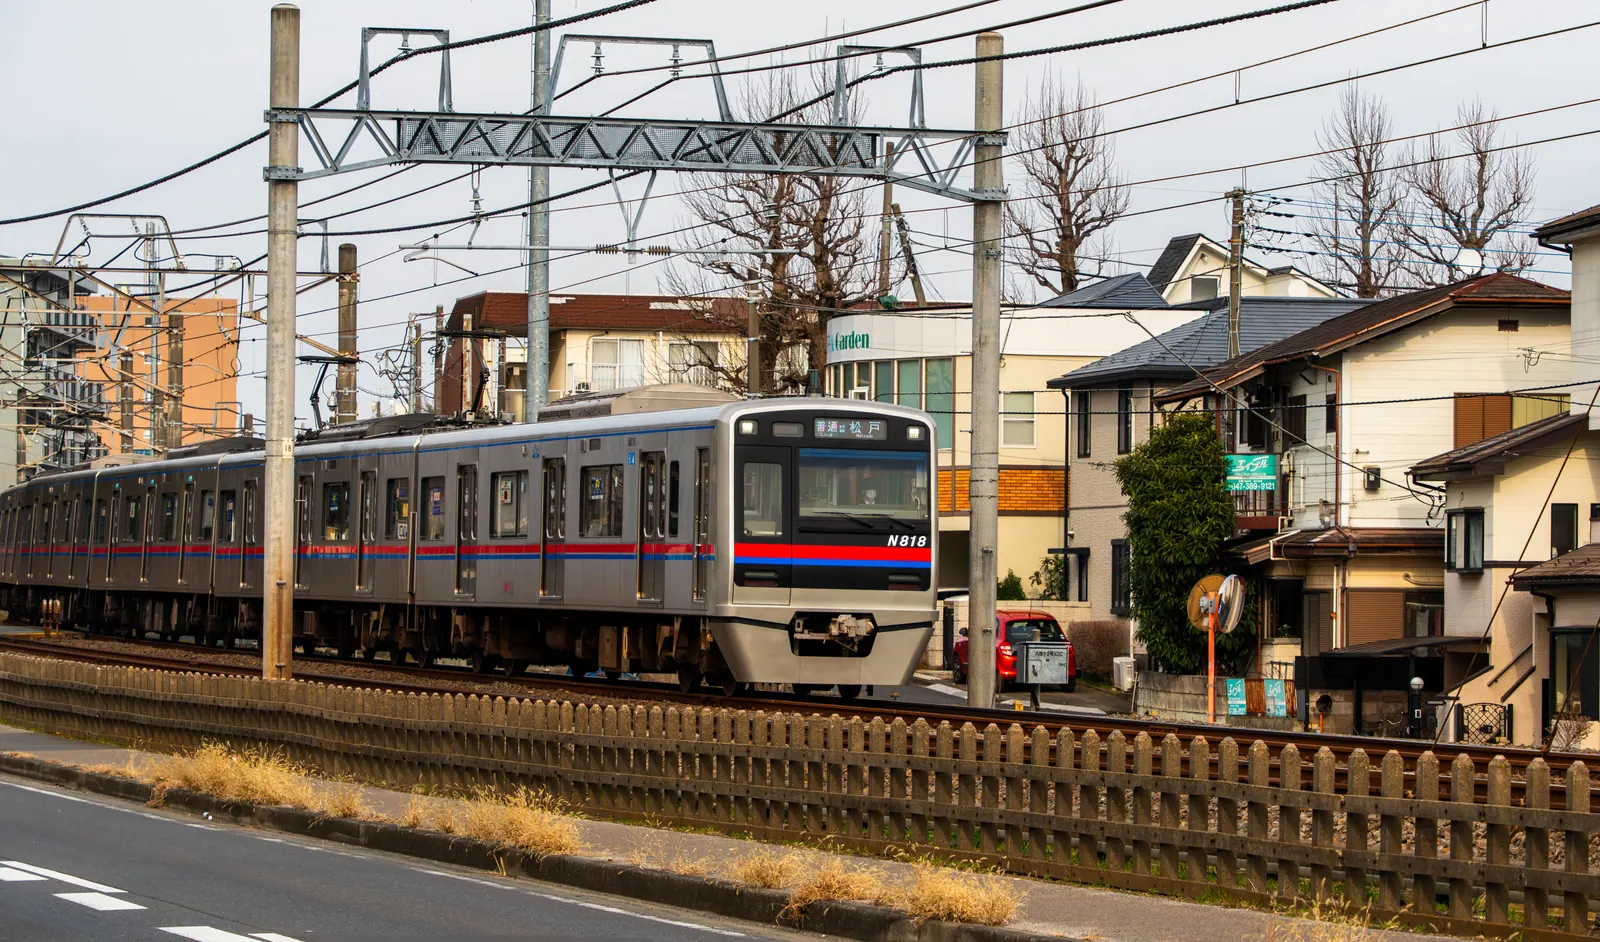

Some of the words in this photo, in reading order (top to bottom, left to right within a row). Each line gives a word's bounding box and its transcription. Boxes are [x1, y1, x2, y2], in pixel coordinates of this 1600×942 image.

[835, 330, 870, 351] Garden
[816, 421, 838, 432] 普通
[849, 421, 881, 433] 松戸
[1232, 456, 1269, 472] エイブル
[887, 534, 927, 548] N818
